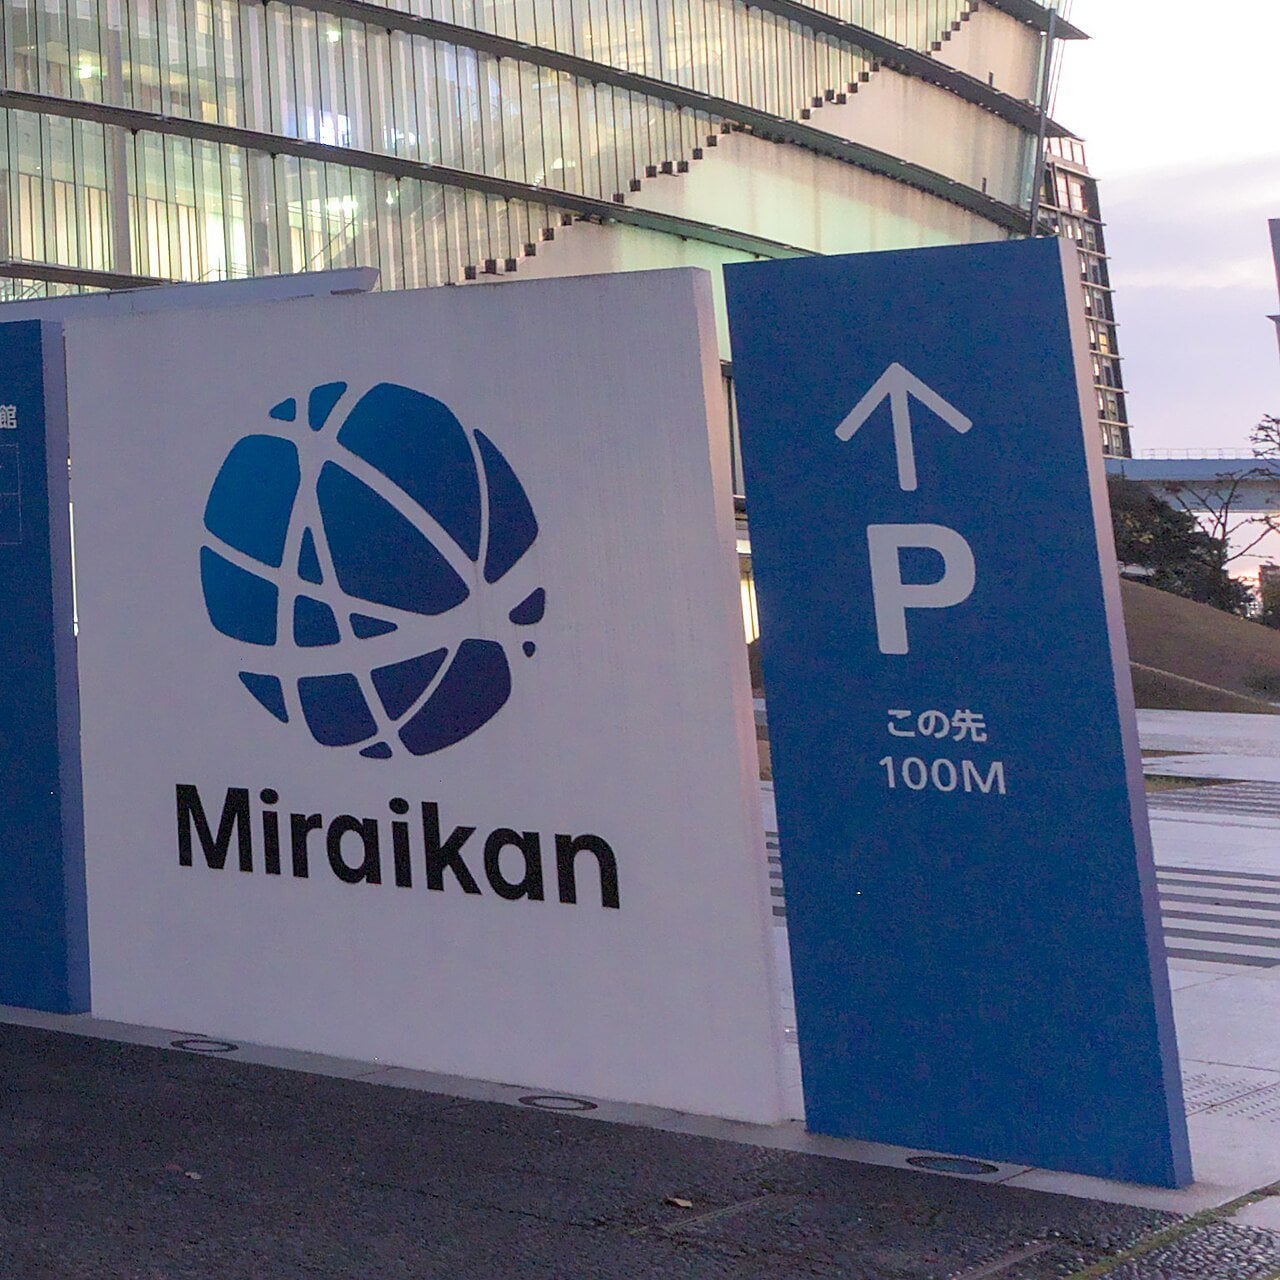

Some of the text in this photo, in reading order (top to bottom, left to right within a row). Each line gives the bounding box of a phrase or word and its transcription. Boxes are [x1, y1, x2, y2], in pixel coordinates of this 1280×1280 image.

[866, 524, 977, 656] P
[888, 709, 988, 742] この先
[879, 756, 1007, 795] 100M
[175, 783, 621, 910] Miraikan
